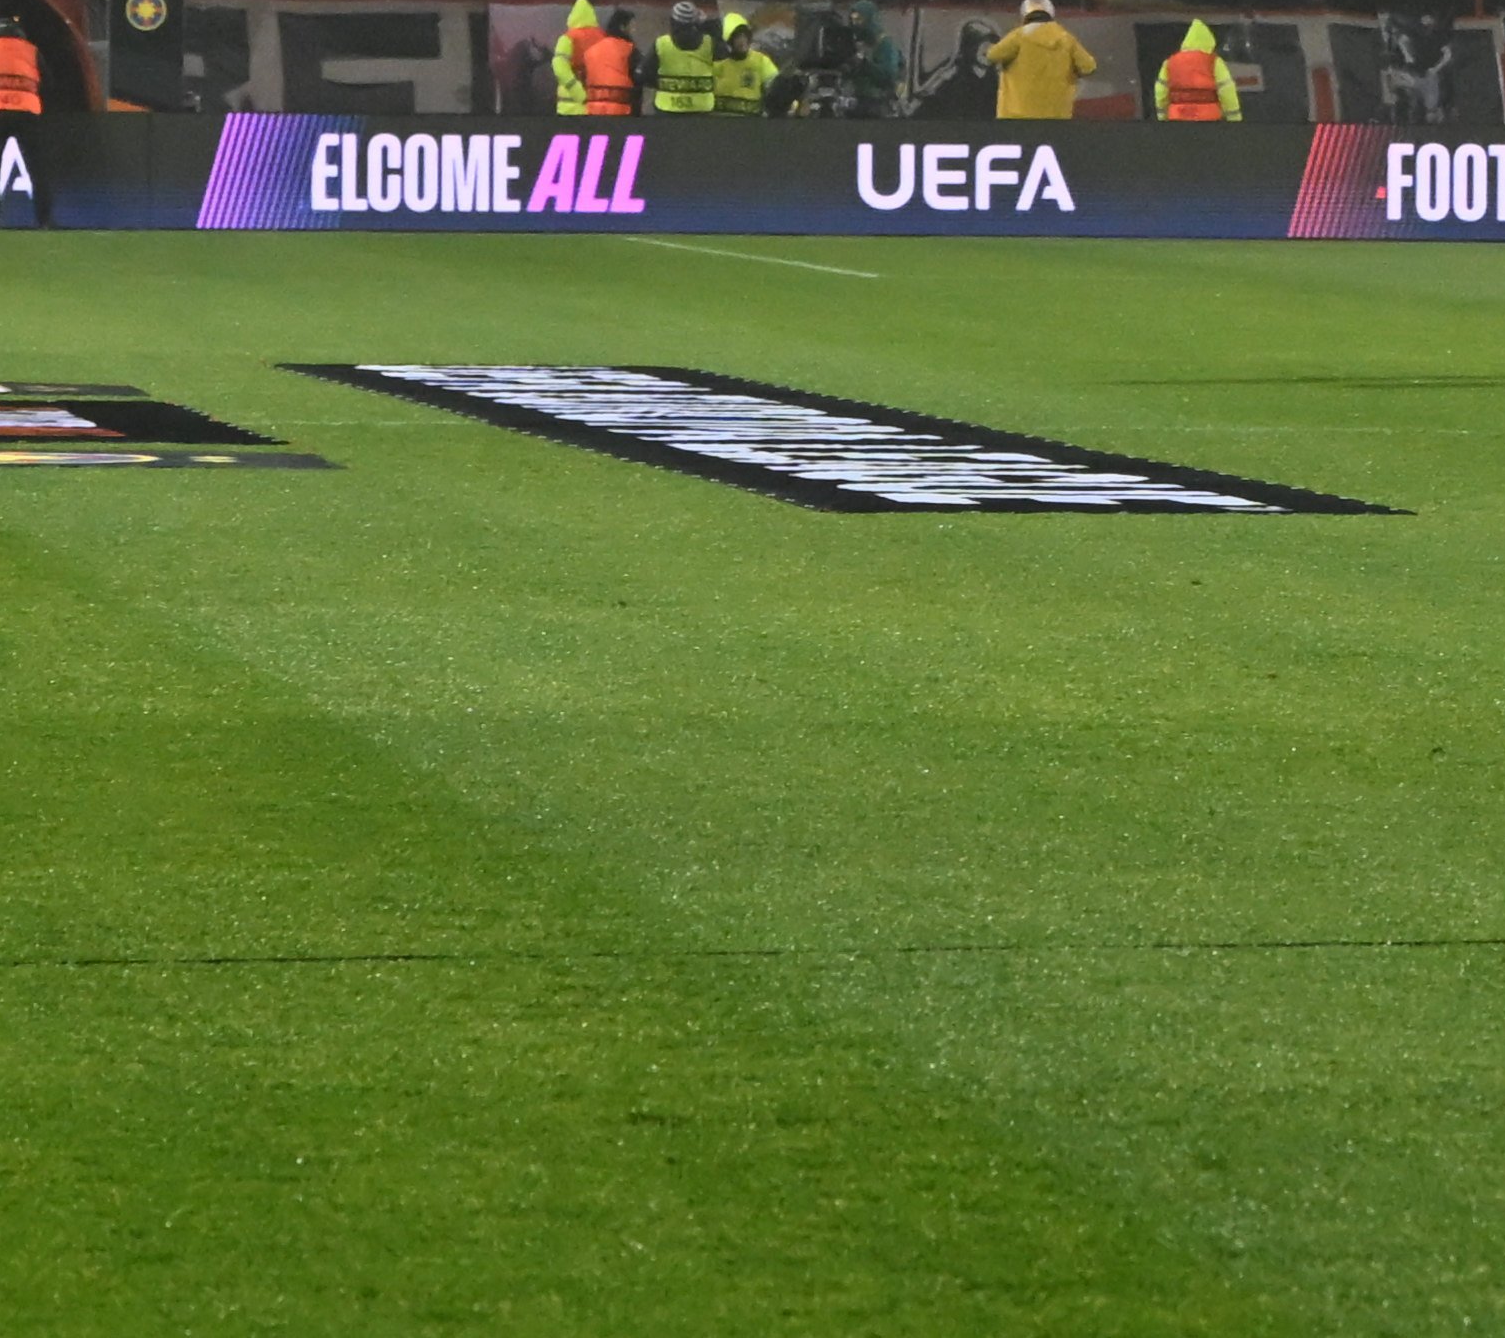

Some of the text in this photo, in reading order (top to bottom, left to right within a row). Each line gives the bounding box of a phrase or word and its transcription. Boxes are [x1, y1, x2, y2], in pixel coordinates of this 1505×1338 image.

[310, 131, 646, 215] ELCOME ALL
[856, 142, 1076, 212] UEFA
